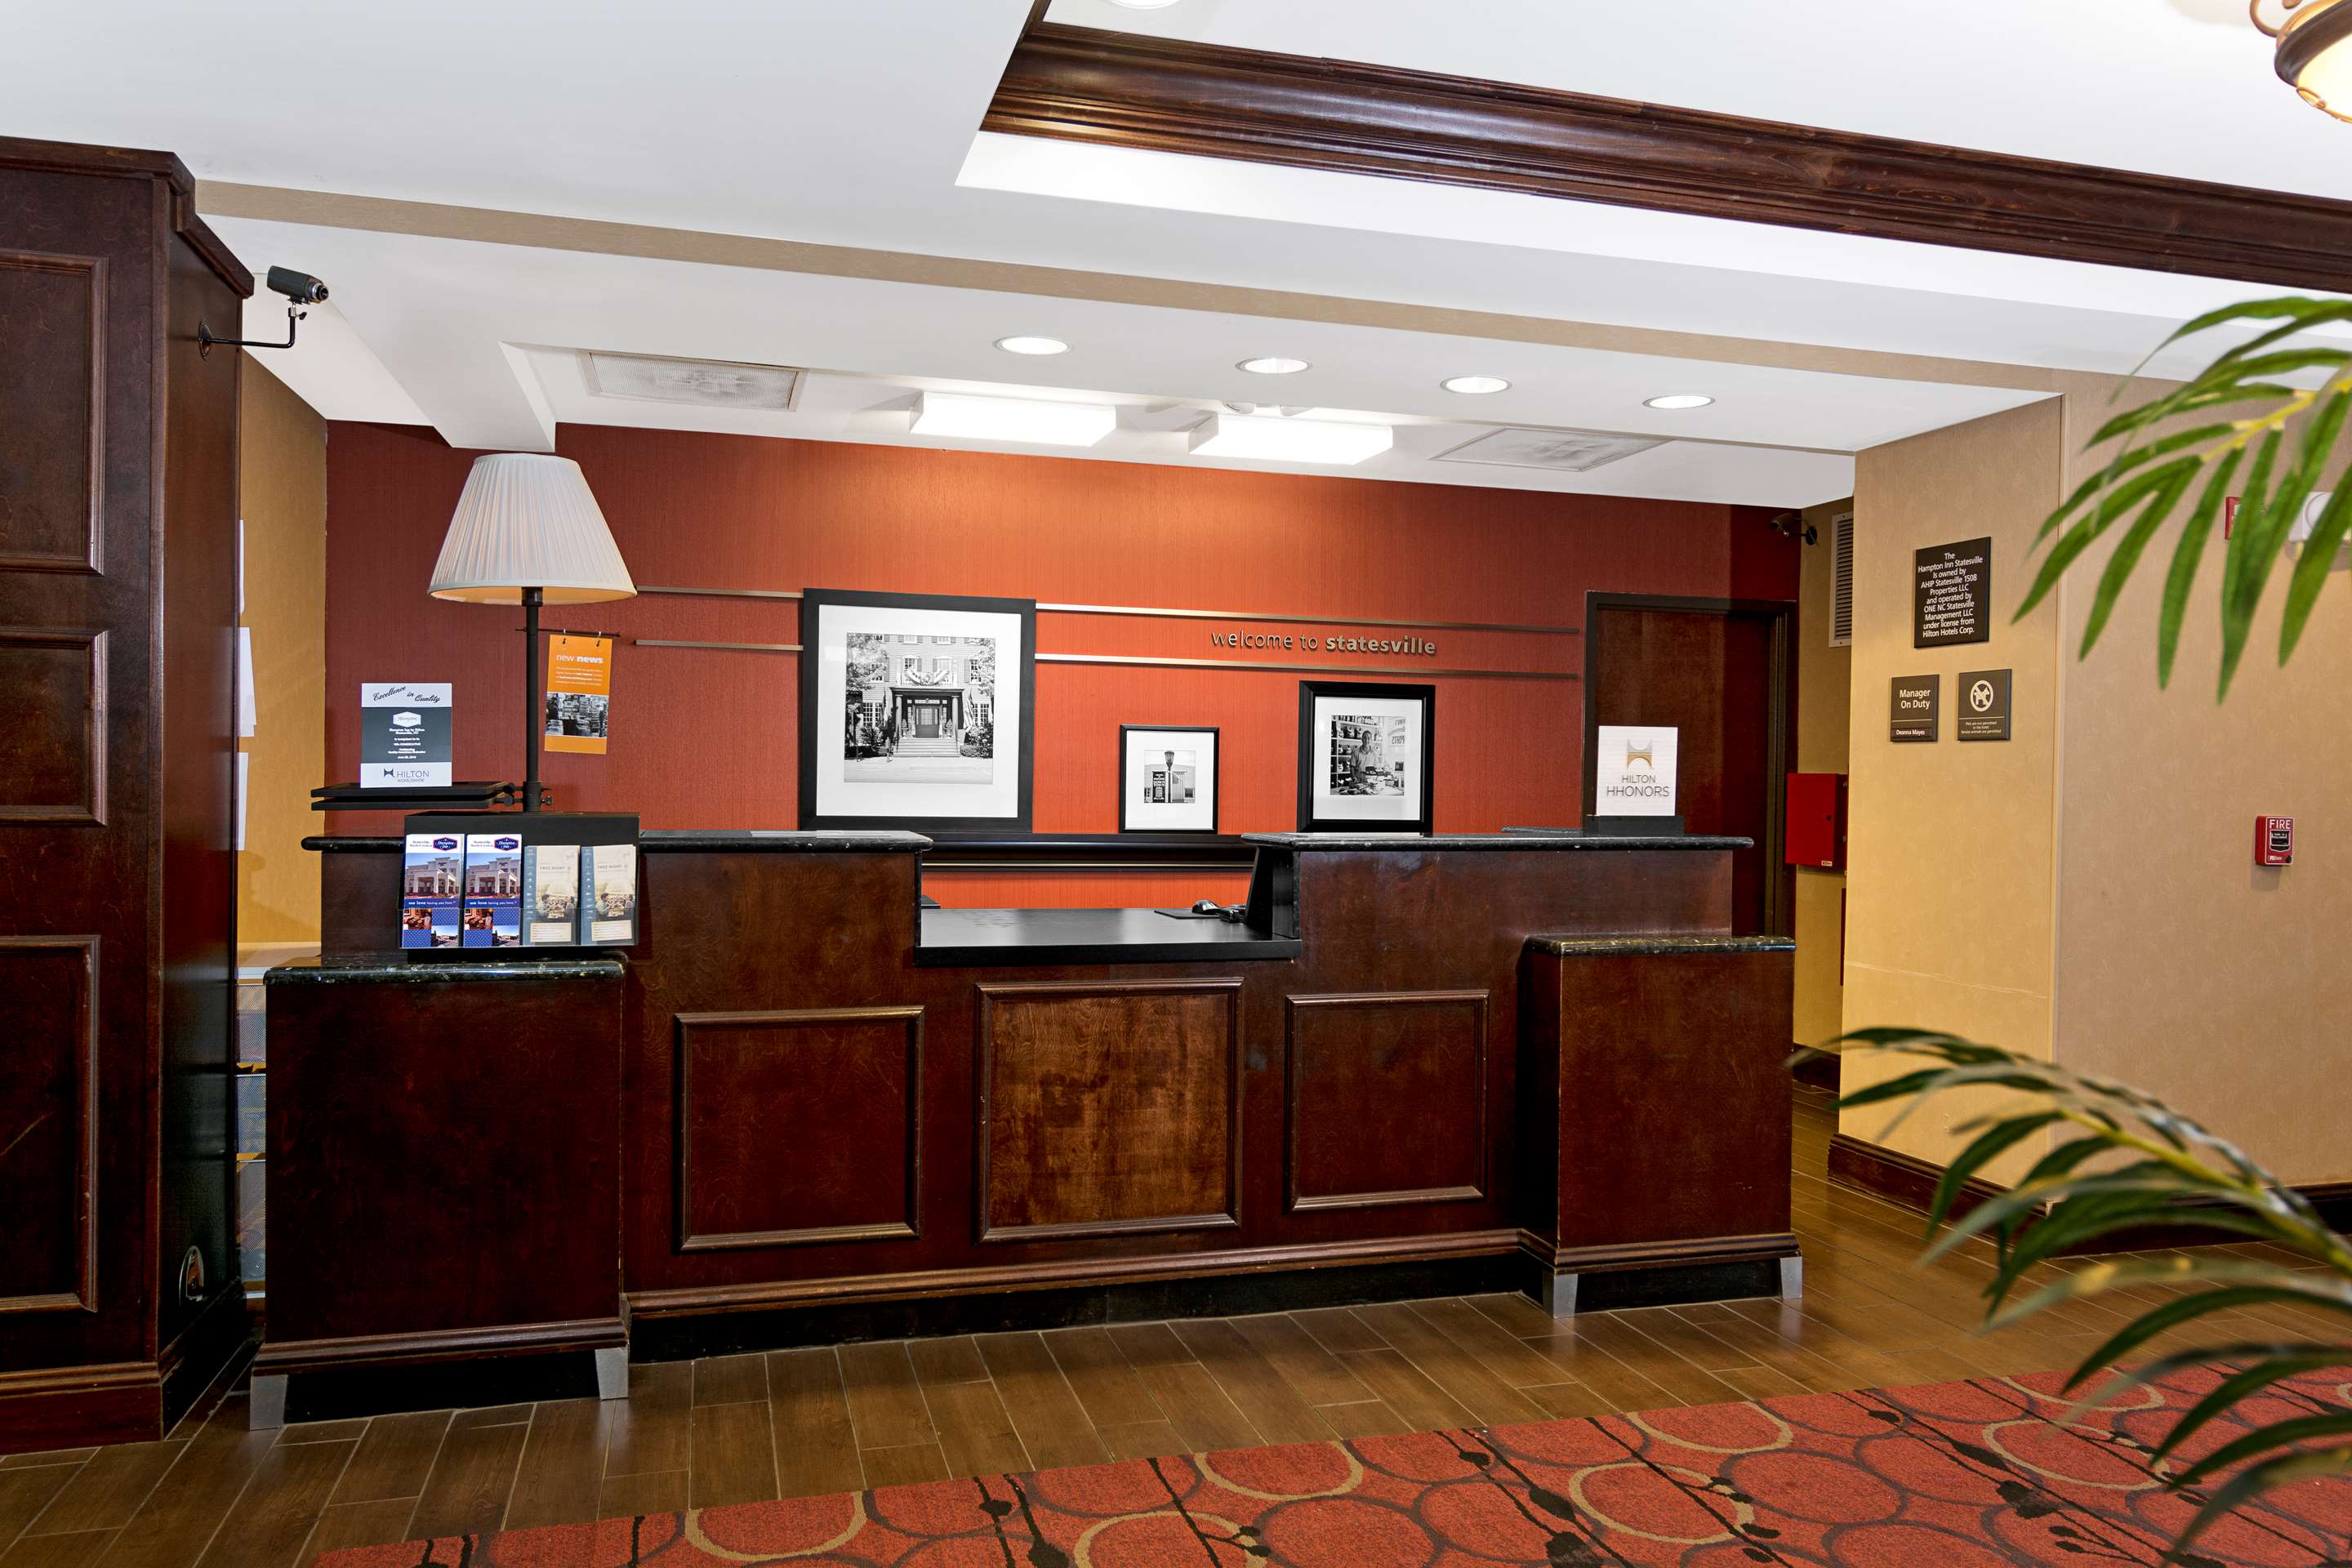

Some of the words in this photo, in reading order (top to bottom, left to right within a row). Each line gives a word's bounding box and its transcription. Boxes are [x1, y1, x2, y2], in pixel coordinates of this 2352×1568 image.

[1944, 552, 1955, 560] The
[1918, 563, 1943, 573] Hampton
[1954, 556, 1983, 567] Statesville
[1938, 568, 1958, 577] owned
[1959, 568, 1967, 577] by
[1921, 581, 1935, 589] AHIP
[1936, 576, 1962, 586] Statesville
[1964, 573, 1977, 582] 1508
[1930, 586, 1958, 597] Properties
[1958, 583, 1969, 591] LLC
[1926, 596, 1937, 604] and
[1938, 593, 1963, 604] operated
[1965, 592, 1972, 601] by
[1923, 605, 1936, 613] ONE
[1937, 604, 1946, 612] NC
[1947, 600, 1975, 611] Statesville
[1925, 610, 1962, 621] Management
[1962, 608, 1973, 617] LLC
[1923, 621, 1940, 630] under
[1940, 618, 1959, 628] license
[1960, 617, 1975, 626] from
[1922, 630, 1939, 638] Hilton
[1940, 627, 1958, 636] Hotels
[1959, 626, 1975, 635] Corp.
[1211, 630, 1294, 648] welcome
[1300, 634, 1318, 650] to
[1325, 635, 1436, 655] statesville
[372, 685, 407, 702] Excellence
[414, 694, 441, 704] Quality
[1900, 689, 1931, 699] Manager
[1901, 700, 1911, 709] On
[1913, 700, 1931, 710] Duty
[396, 770, 430, 778] HILTON
[1622, 774, 1656, 784] HILTON
[1606, 786, 1670, 797] HHONORS
[2269, 819, 2292, 830] FIRE
